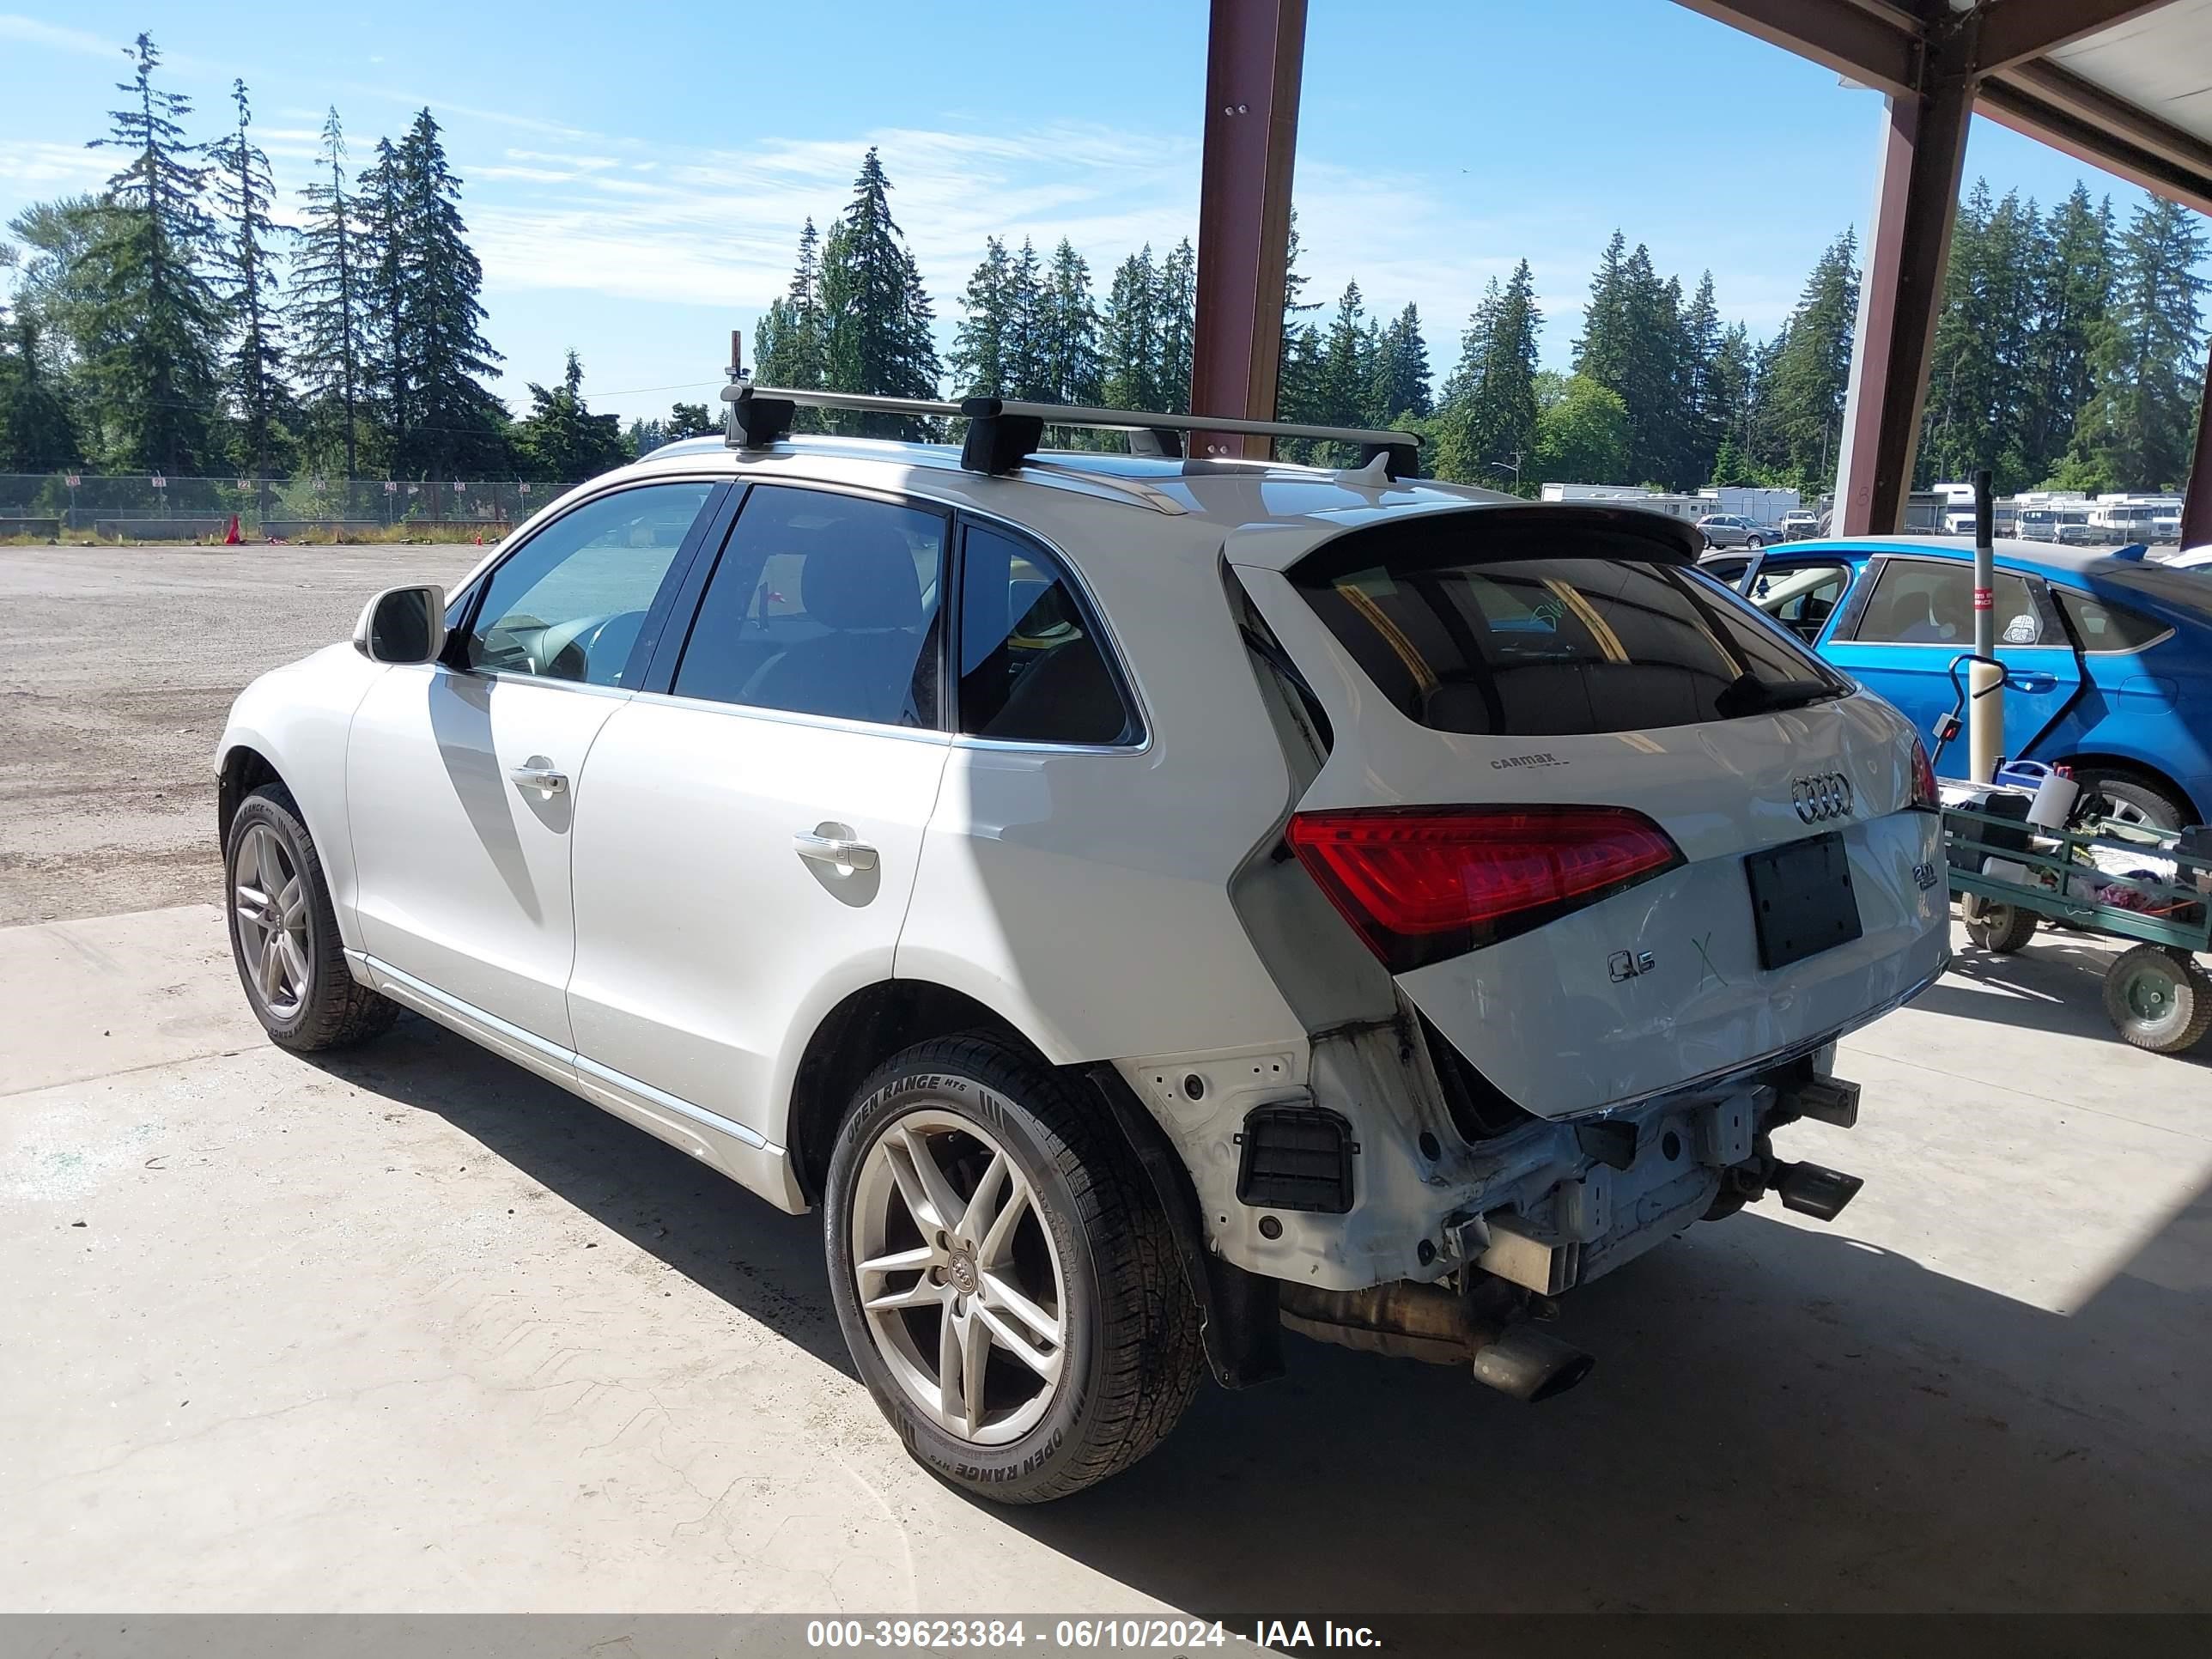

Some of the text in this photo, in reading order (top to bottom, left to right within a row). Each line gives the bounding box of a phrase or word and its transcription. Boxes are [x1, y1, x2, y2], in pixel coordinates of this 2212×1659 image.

[1607, 950, 1656, 983] Q5
[847, 1075, 968, 1144] OPEN RANGE HTS
[1023, 1427, 1063, 1476] OPEN
[955, 1462, 1018, 1483] RANGE
